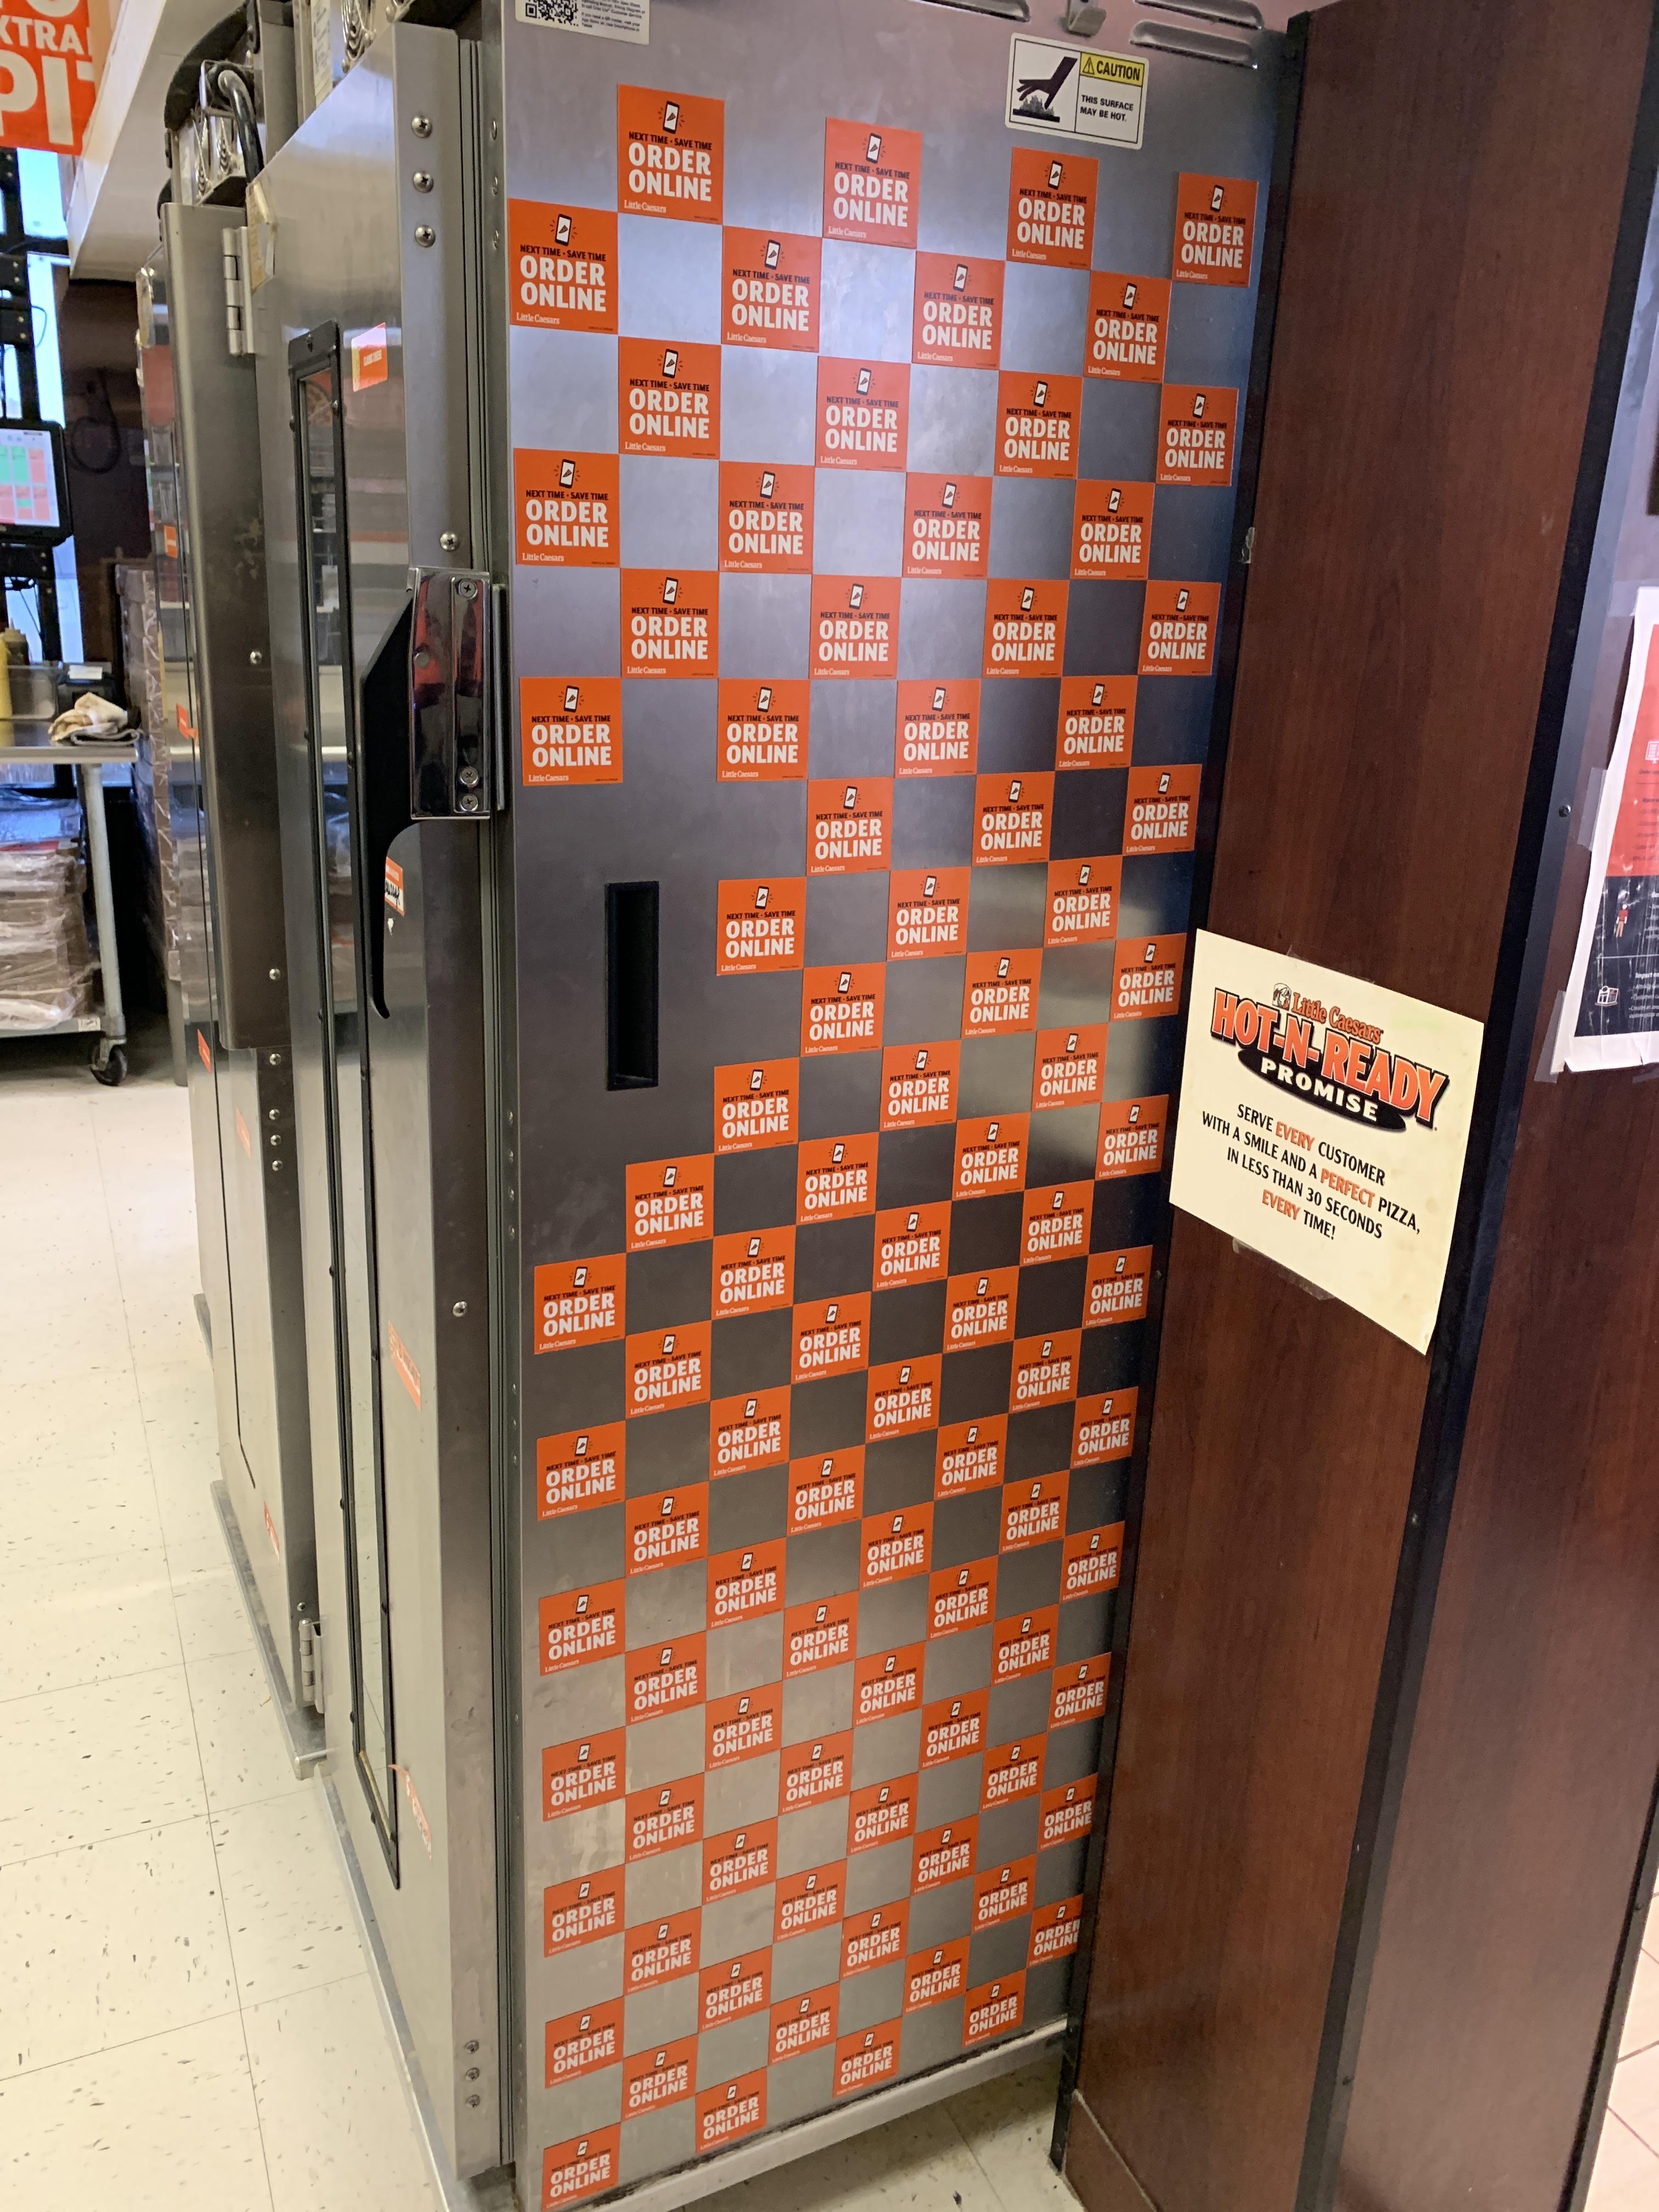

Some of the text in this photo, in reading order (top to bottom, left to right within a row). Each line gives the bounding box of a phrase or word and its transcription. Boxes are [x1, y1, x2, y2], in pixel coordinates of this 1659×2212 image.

[1097, 60, 1141, 81] CAUTION
[1080, 106, 1127, 121] MAY BE HOT.
[1081, 95, 1134, 111] THIS SURFACE
[629, 132, 713, 149] NEXT TIME SAVE TIME
[629, 142, 711, 175] ORDER
[629, 170, 712, 202] ONLINE
[834, 172, 907, 202] ORDER
[1037, 190, 1051, 199] TIME
[1072, 195, 1086, 204] TIME
[624, 200, 667, 213] Little Caesars
[834, 198, 908, 227] ONLINE
[1019, 198, 1085, 225] ORDER
[1018, 222, 1085, 249] ONLINE
[1183, 221, 1244, 246] ORDER
[521, 245, 606, 261] NEXT TIME SAVE TIME
[1182, 244, 1243, 268] ONLINE
[521, 255, 605, 286] ORDER
[521, 282, 606, 312] ONLINE
[732, 279, 808, 307] ORDER
[516, 312, 560, 324] Little Caesars
[732, 304, 809, 331] ONLINE
[1095, 318, 1157, 343] ORDER
[1093, 340, 1156, 365] ONLINE
[630, 388, 708, 414] ORDER
[630, 413, 709, 438] ONLINE
[1006, 416, 1070, 439] ORDER
[625, 442, 665, 452] Little Caesars
[1005, 439, 1070, 461] ONLINE
[1167, 428, 1225, 448] ORDER
[1165, 449, 1224, 469] ONLINE
[526, 499, 607, 523] ORDER
[527, 524, 608, 548] ONLINE
[913, 518, 979, 540] ORDER
[522, 552, 563, 562] Little Caesars
[912, 541, 979, 561] ONLINE
[631, 616, 707, 637] ORDER
[1150, 622, 1207, 640] ORDER
[631, 639, 708, 659] ONLINE
[1148, 641, 1206, 659] ONLINE
[532, 724, 610, 744] ORDER
[905, 721, 968, 740] ORDER
[533, 746, 611, 767] ONLINE
[904, 742, 969, 761] ONLINE
[528, 773, 568, 782] Little Caesars
[1133, 803, 1188, 821] ORDER
[1131, 821, 1188, 840] ONLINE
[726, 918, 794, 938] ORDER
[726, 938, 794, 958] ONLINE
[1120, 969, 1174, 990] ORDER
[1119, 987, 1173, 1007] ONLINE
[1291, 992, 1382, 1044] Little Caesars
[1211, 989, 1448, 1126] HOT-N-READY
[1261, 1057, 1378, 1121] PROMISE
[723, 1097, 788, 1120] ORDER
[723, 1115, 789, 1138] ONLINE
[1237, 1104, 1385, 1186] SERVE EVERY CUSTOMER
[805, 1169, 867, 1192] ORDER
[1203, 1111, 1420, 1234] WITH A SMILE AND A PERFECT PIZZA,
[805, 1186, 867, 1209] ONLINE
[1227, 1147, 1383, 1239] IN LESS THAN 30 SECONDS
[1029, 1214, 1082, 1236] ORDER
[1262, 1189, 1336, 1240] EVERY TIME!
[1028, 1229, 1082, 1252] ONLINE
[1092, 1278, 1143, 1299] ORDER
[544, 1292, 614, 1318] ORDER
[1090, 1293, 1142, 1314] ONLINE
[544, 1310, 614, 1336] ONLINE
[634, 1357, 701, 1384] ORDER
[634, 1375, 701, 1402] ONLINE
[546, 1458, 614, 1487] ORDER
[546, 1475, 616, 1504] ONLINE
[868, 1535, 923, 1560] ORDER
[867, 1549, 924, 1576] ONLINE
[999, 1634, 1049, 1660] ORDER
[998, 1647, 1049, 1673] ONLINE
[713, 1715, 772, 1742] ORDER
[713, 1729, 772, 1757] ONLINE
[551, 1762, 615, 1791] ORDER
[551, 1776, 616, 1805] ONLINE
[782, 1889, 836, 1916] ORDER
[781, 1902, 836, 1929] ONLINE
[554, 2029, 614, 2059] ORDER
[554, 2041, 614, 2073] ONLINE
[551, 2154, 610, 2184] ORDER
[550, 2166, 610, 2197] ONLINE
